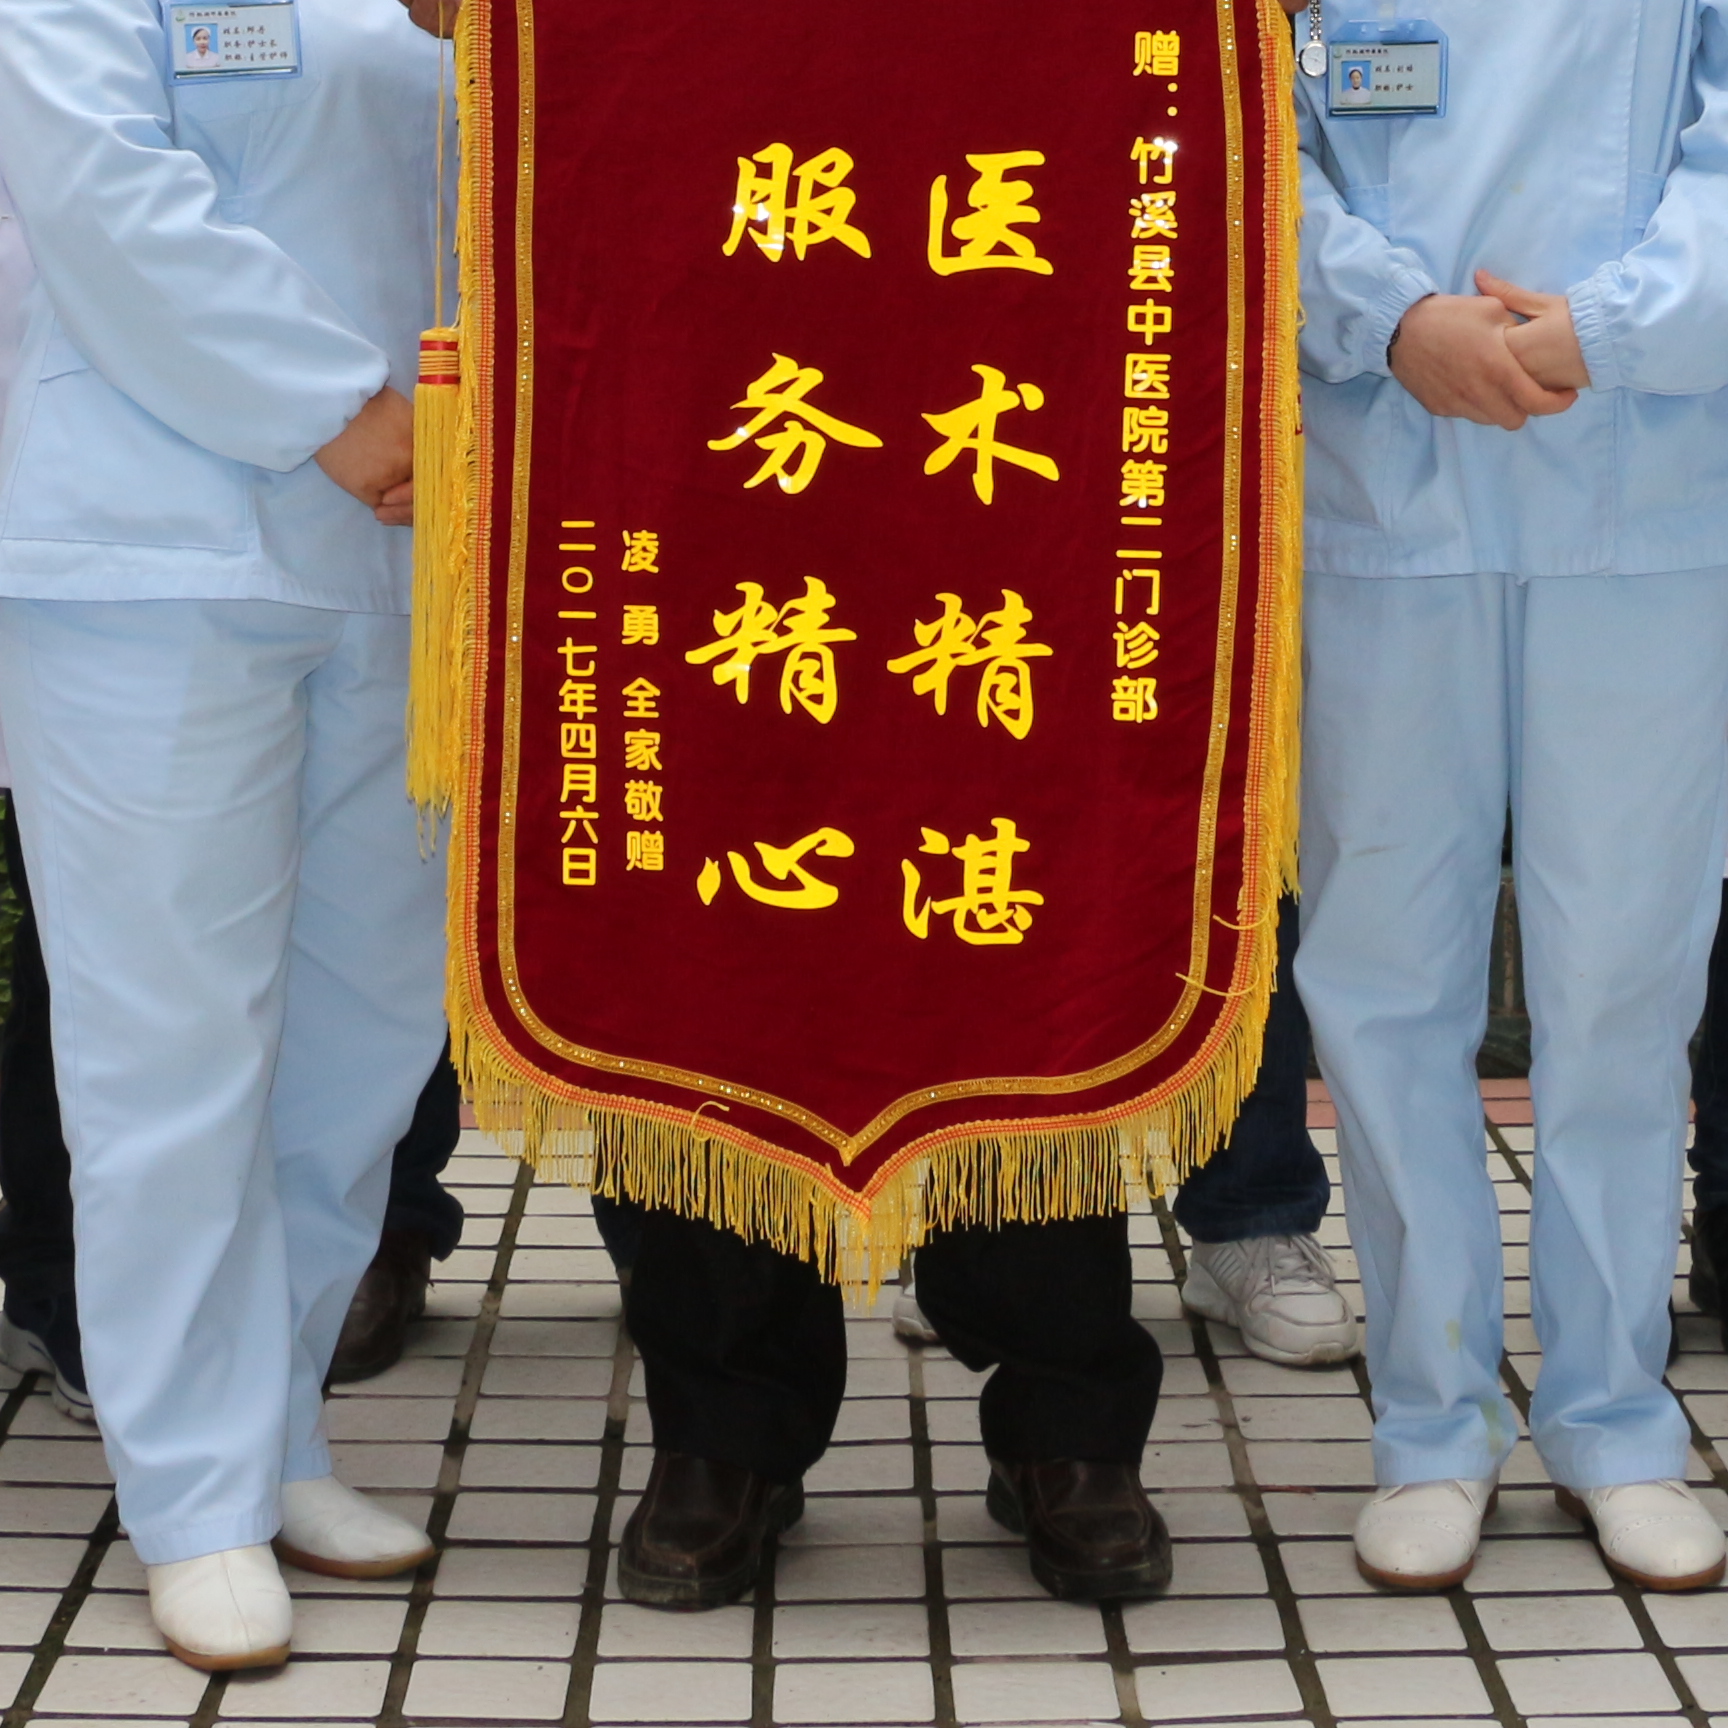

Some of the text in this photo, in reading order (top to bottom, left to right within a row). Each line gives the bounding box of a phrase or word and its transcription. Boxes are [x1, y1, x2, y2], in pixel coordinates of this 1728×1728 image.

[685, 142, 884, 914] 服务精心
[886, 148, 1060, 948] 医术精湛
[1110, 28, 1181, 725] 赠：竹溪县中医院第二门诊部
